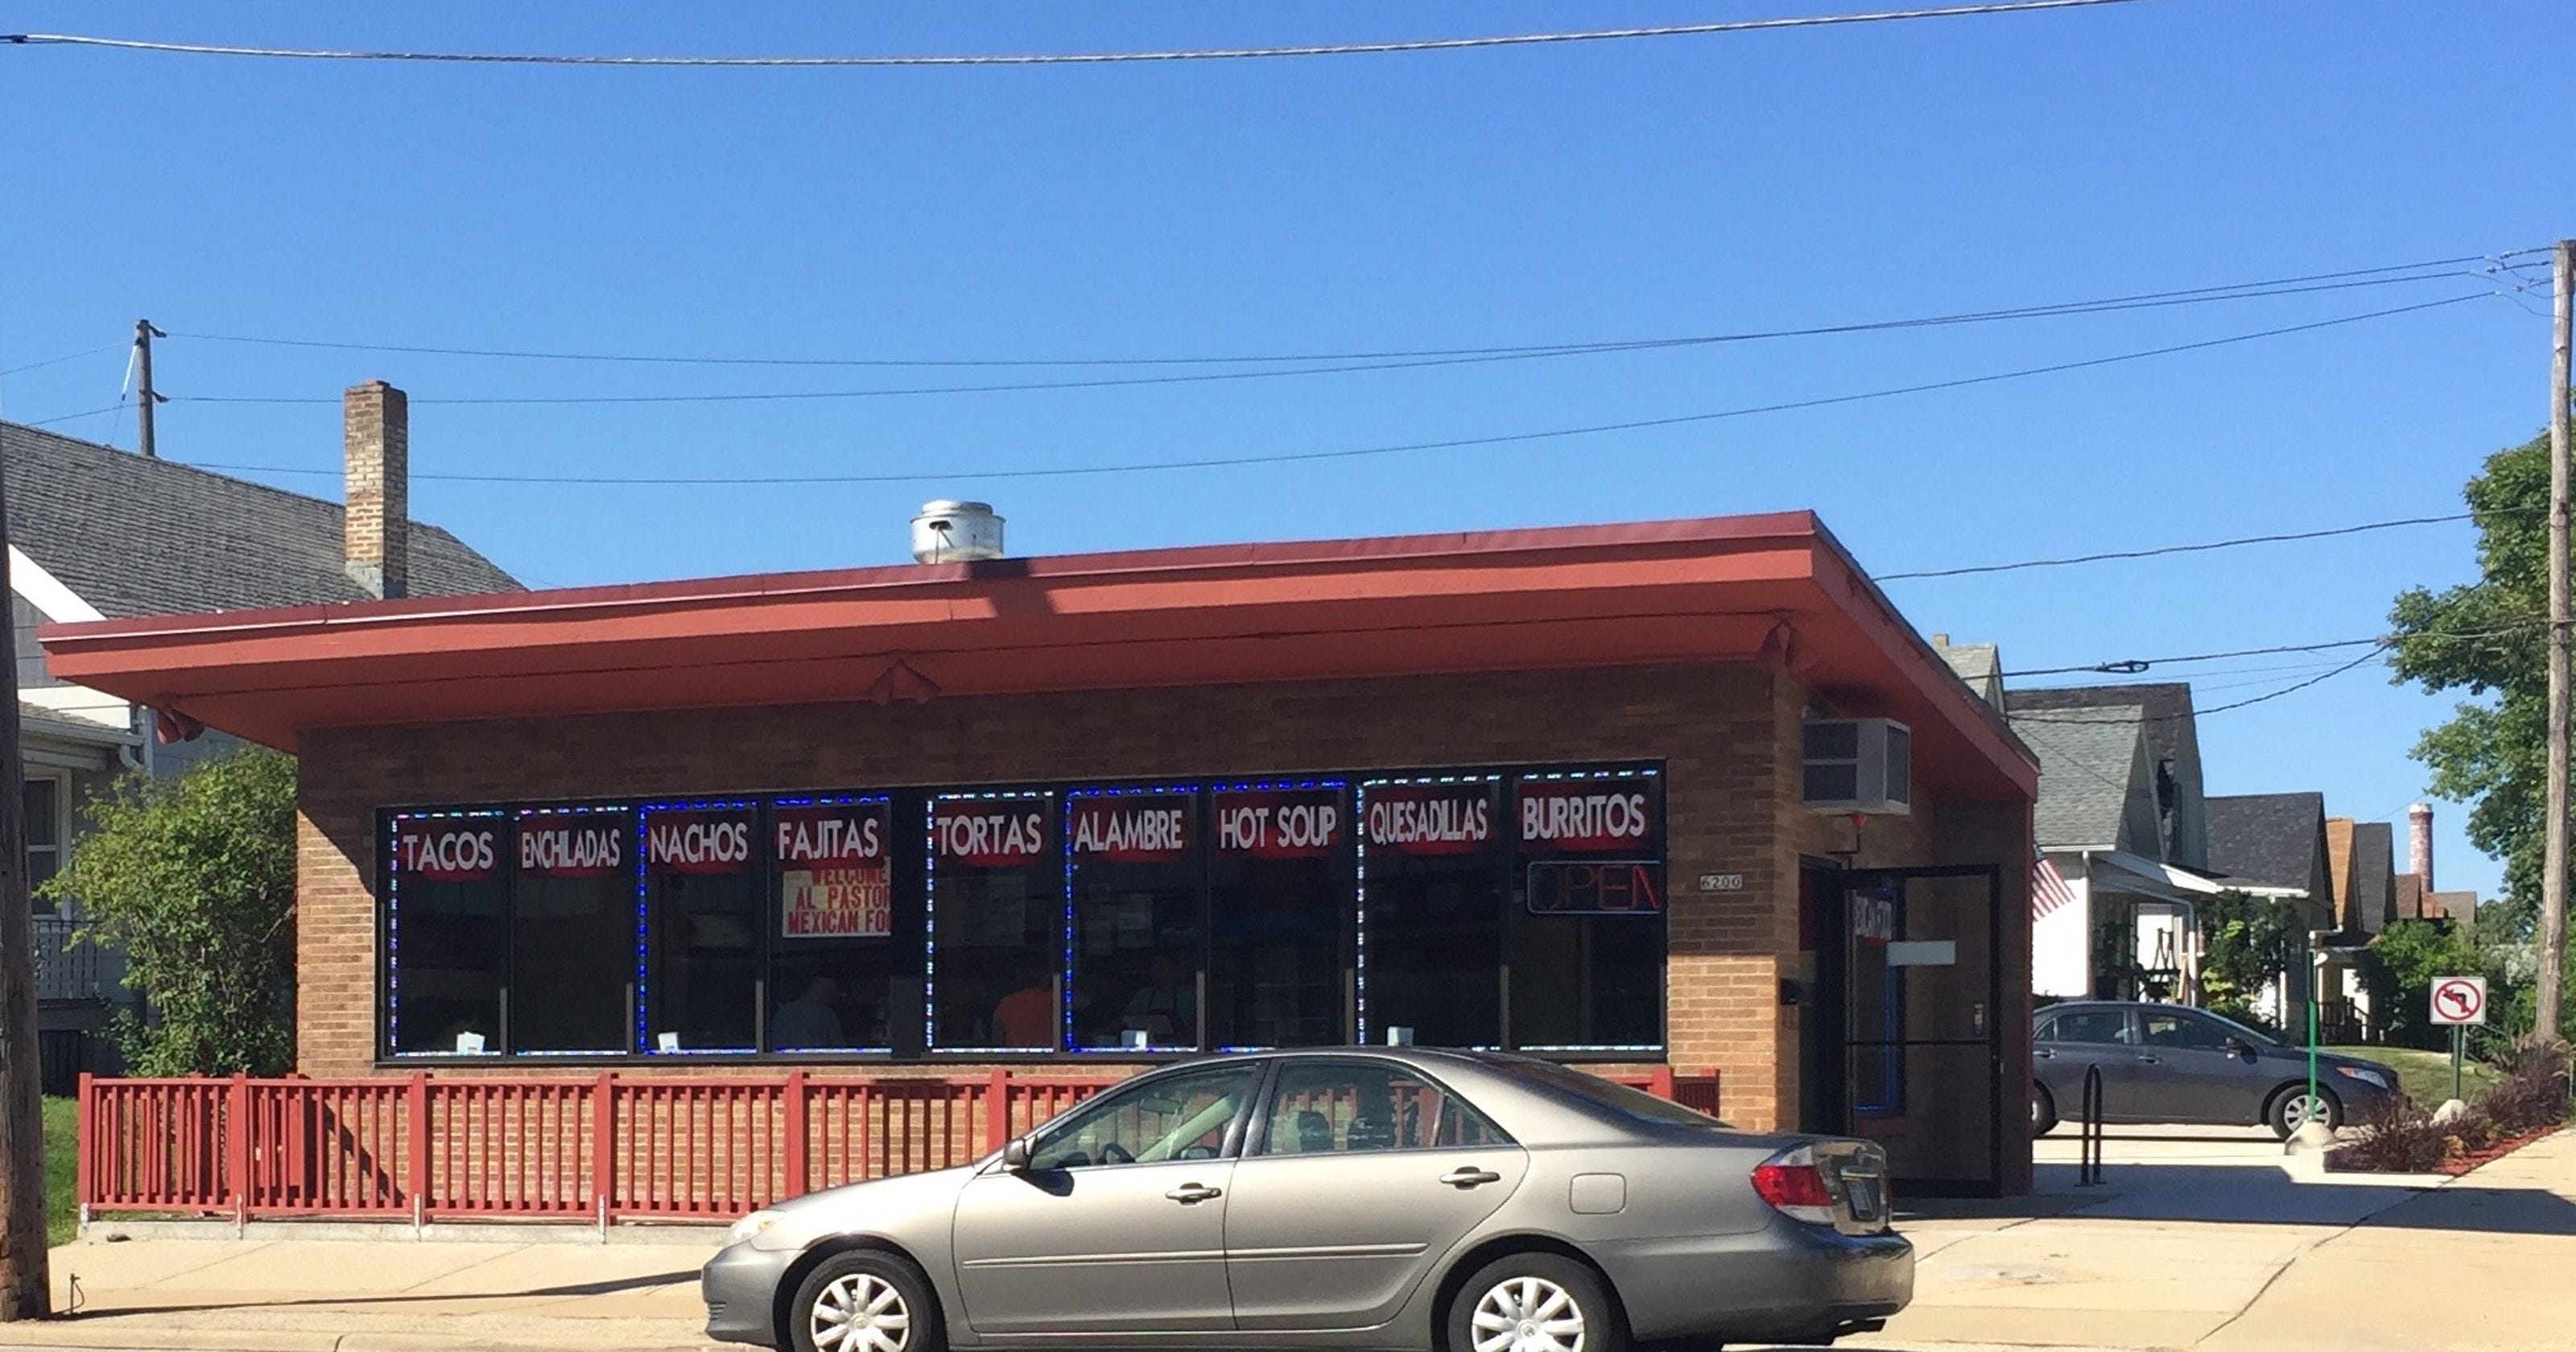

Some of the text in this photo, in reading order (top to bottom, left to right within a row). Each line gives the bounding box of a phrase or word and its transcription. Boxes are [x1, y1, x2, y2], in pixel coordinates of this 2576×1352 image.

[937, 814, 1042, 856] TORTAS
[1074, 810, 1183, 852] ALAMBRE
[1220, 805, 1337, 850] HOT SOUP
[1370, 797, 1488, 846] QUESADILLAS
[1522, 793, 1646, 841] BURRITOS
[402, 831, 494, 872] TACOS
[522, 829, 620, 868] ENCHILADAS
[650, 822, 749, 864] NACHOS
[778, 818, 879, 860] FAJITAS
[795, 886, 816, 909] AL
[1532, 864, 1662, 910] OPEN
[1701, 876, 1740, 888] 6200
[788, 910, 859, 934] MEXICAN
